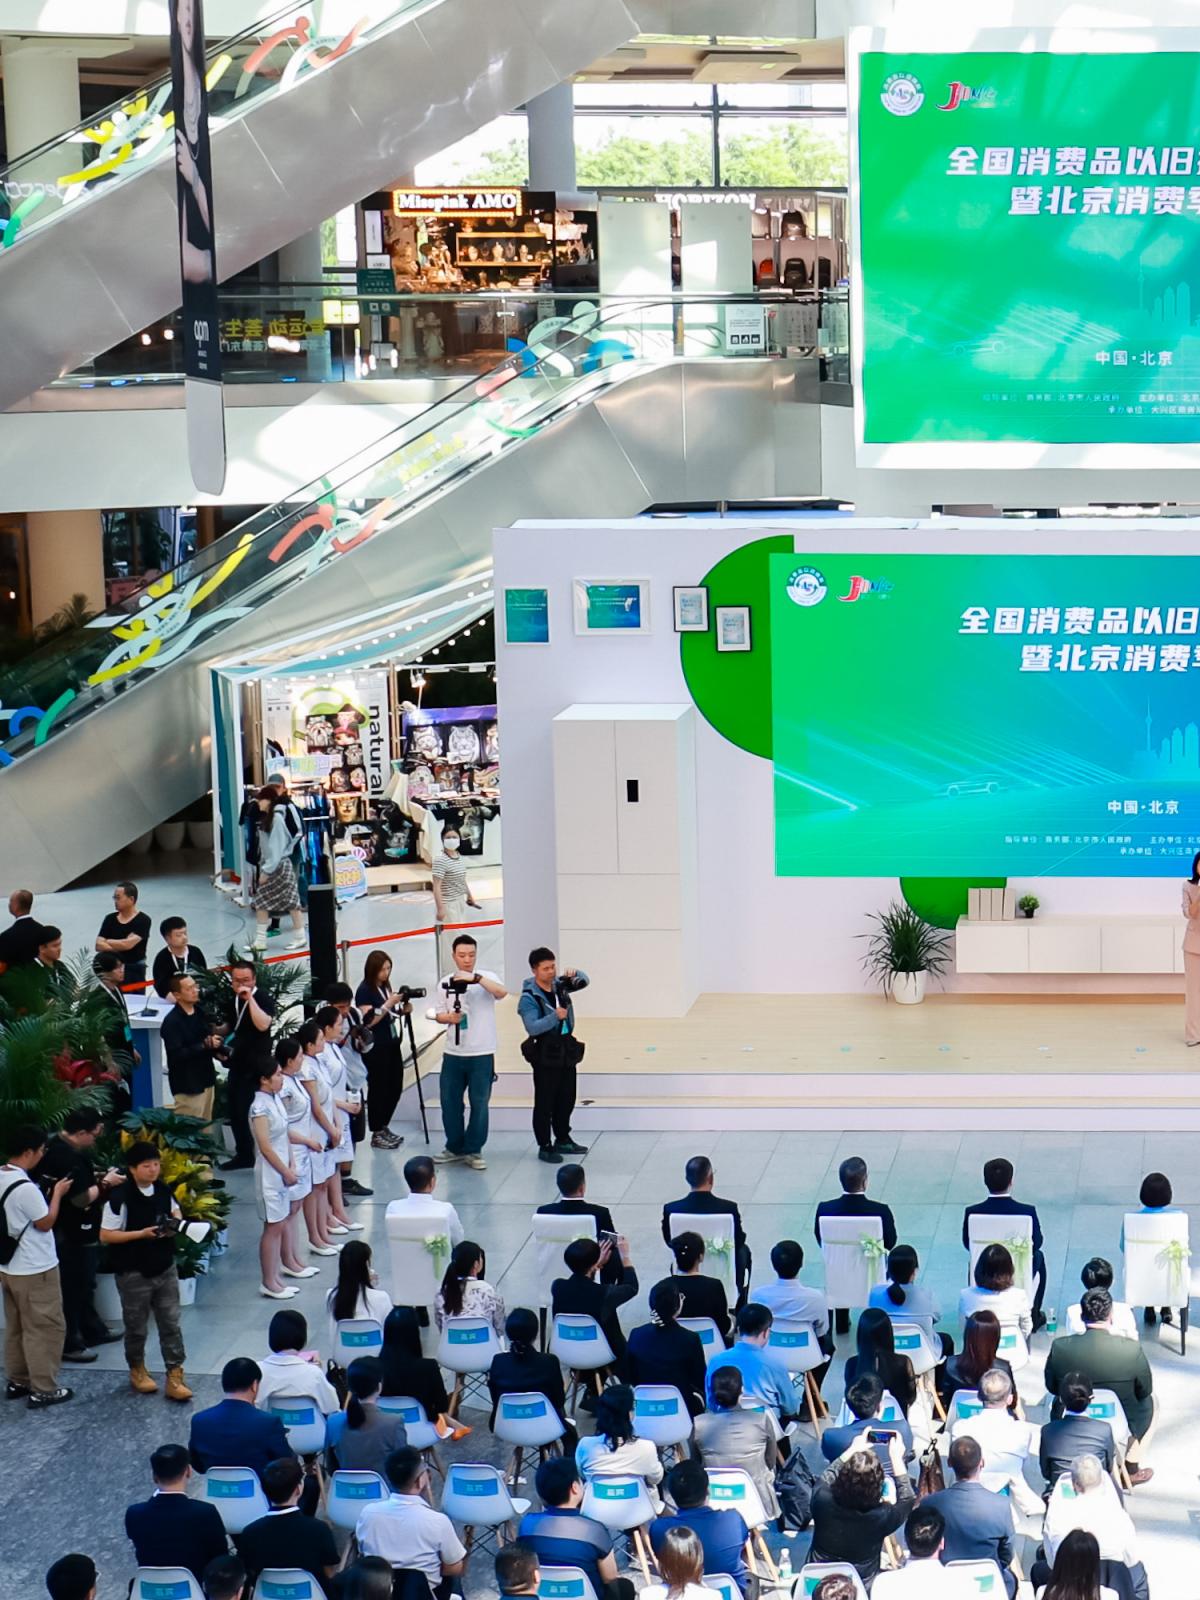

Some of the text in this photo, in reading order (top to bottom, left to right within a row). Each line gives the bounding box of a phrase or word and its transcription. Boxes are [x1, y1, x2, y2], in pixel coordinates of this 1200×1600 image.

[472, 193, 517, 209] AMO
[1094, 349, 1174, 367] 中国·北京
[368, 704, 385, 800] natural
[1107, 800, 1180, 815] 中国·北京
